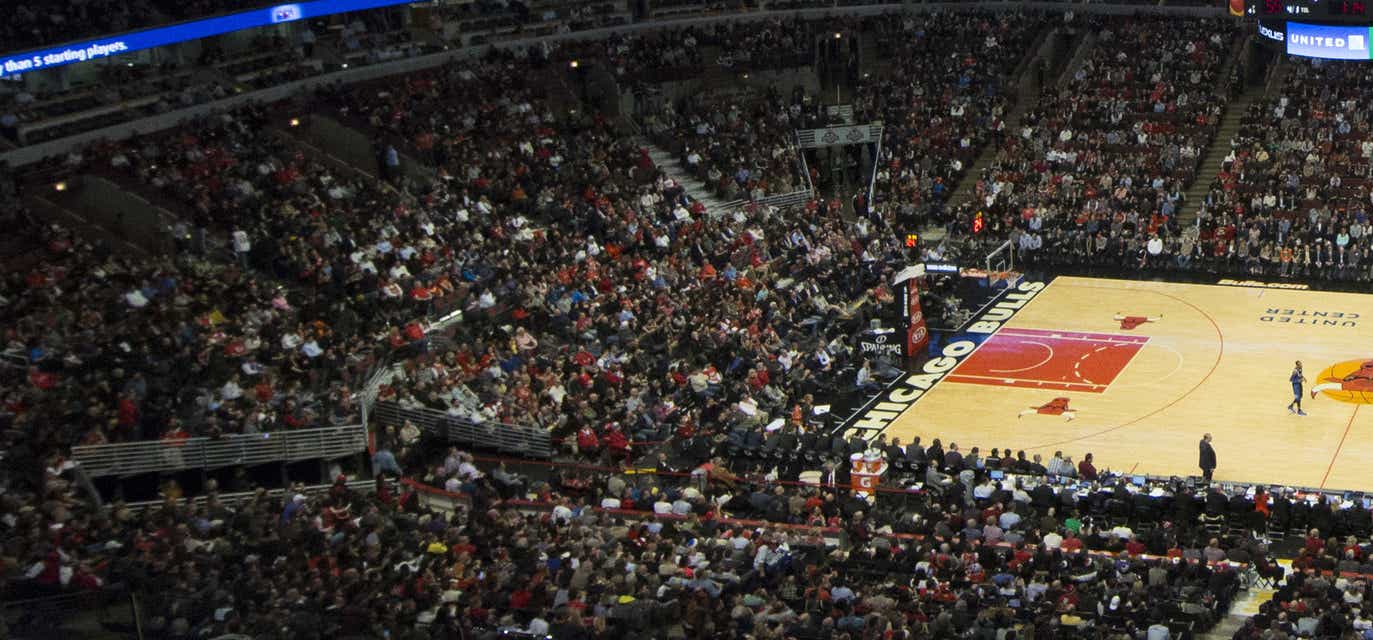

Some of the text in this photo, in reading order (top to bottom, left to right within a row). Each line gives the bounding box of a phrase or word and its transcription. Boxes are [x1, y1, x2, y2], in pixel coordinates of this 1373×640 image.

[1258, 19, 1284, 40] LEXUS
[1291, 33, 1346, 47] UNITED
[5, 59, 33, 72] than
[33, 56, 43, 67] 5
[43, 48, 87, 65] starting
[966, 281, 1046, 333] BULLS
[1266, 308, 1360, 319] CENTER
[1260, 316, 1356, 327] UNITED
